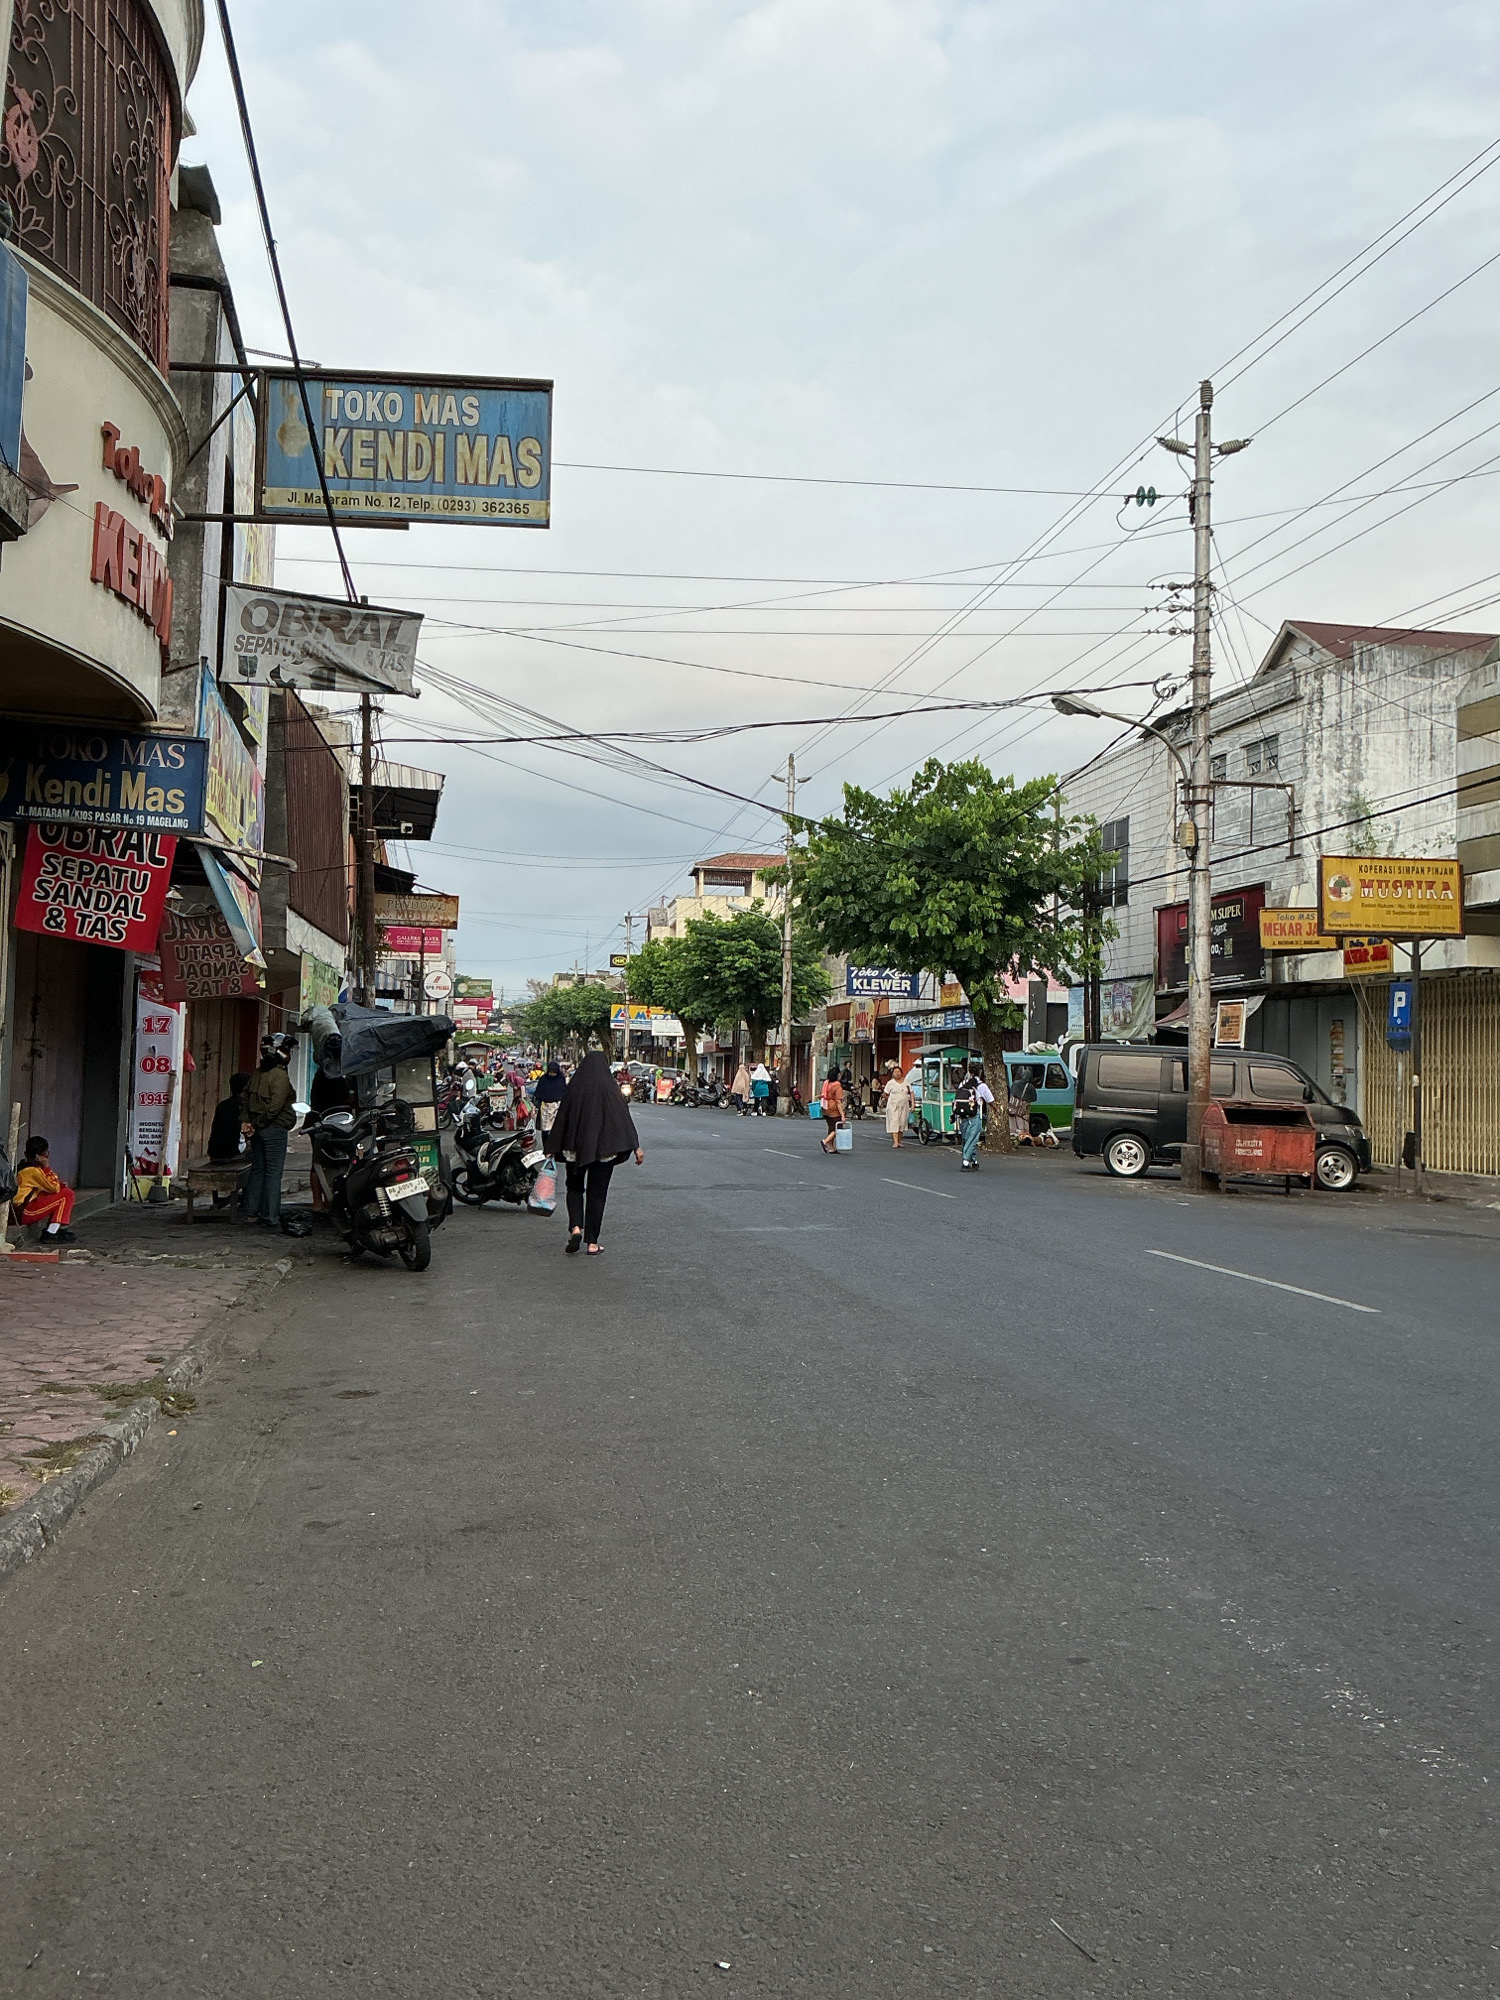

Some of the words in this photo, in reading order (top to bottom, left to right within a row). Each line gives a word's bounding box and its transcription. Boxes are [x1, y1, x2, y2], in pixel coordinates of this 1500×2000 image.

[325, 389, 404, 423] TOKO
[413, 393, 481, 427] MAS
[101, 420, 154, 504] Toko
[322, 425, 446, 484] KENDI
[455, 432, 543, 489] MAS
[287, 492, 301, 504] Jl.
[304, 493, 360, 507] Mataram
[365, 495, 385, 508] No.
[437, 498, 477, 513] (0293)
[481, 501, 530, 515] 362365
[239, 597, 411, 655] OBRAL
[379, 650, 406, 673] TAS
[38, 733, 108, 763] TOKO
[120, 738, 187, 770] MAS
[24, 763, 112, 808] Kendi
[119, 770, 186, 814] Mas
[15, 805, 28, 816] JL.
[94, 812, 121, 824] PASAR
[147, 817, 189, 829] MAGELANG
[40, 851, 151, 895] SEPATU
[1358, 864, 1396, 875] KOPERASI
[1398, 865, 1425, 875] SIMPAN
[1427, 866, 1454, 876] PINJAM
[32, 876, 147, 921] SANDAL
[1358, 879, 1455, 901] MUSTIKA
[1217, 904, 1242, 920] SUPER
[1298, 913, 1316, 921] MAS
[43, 906, 67, 932] &
[74, 910, 128, 943] TAS
[1263, 922, 1302, 937] MEKAR
[849, 966, 879, 978] Toko
[852, 978, 911, 991] KLEWER
[1393, 991, 1406, 1017] P
[142, 1015, 172, 1035] 17
[140, 1056, 172, 1075] 08
[138, 1091, 171, 1107] 1945
